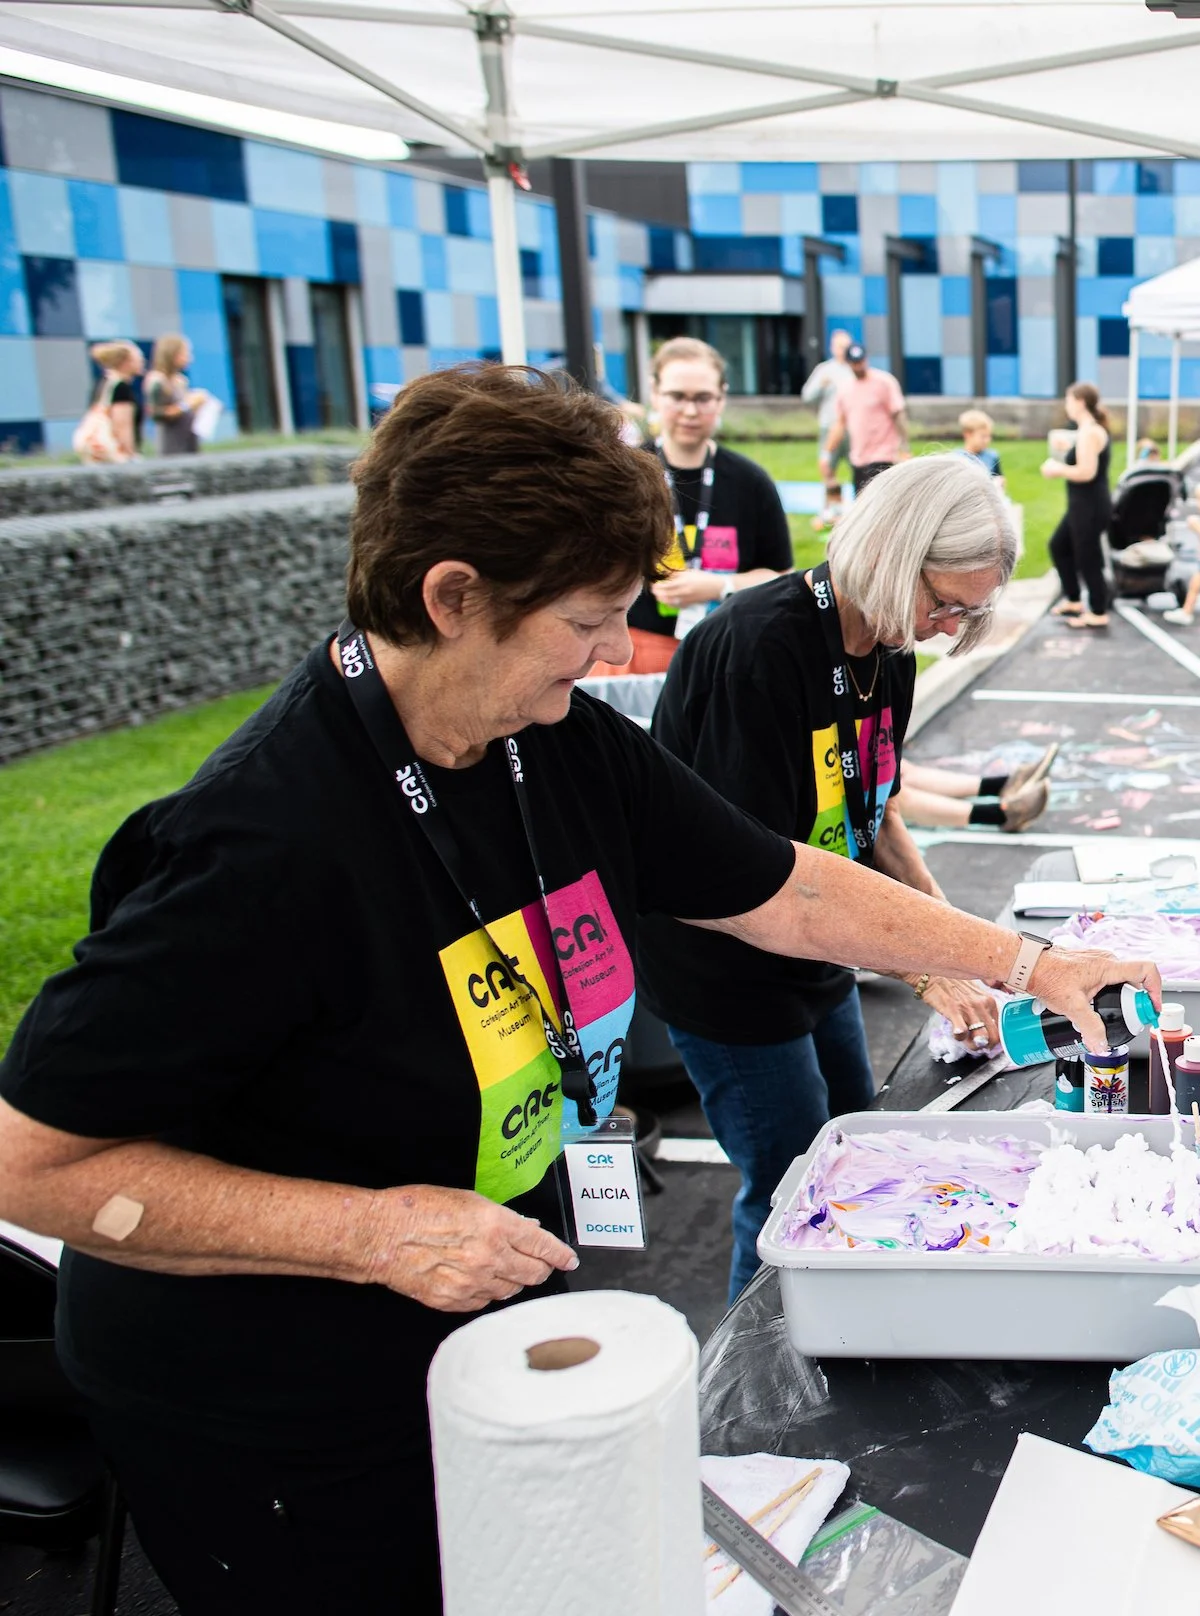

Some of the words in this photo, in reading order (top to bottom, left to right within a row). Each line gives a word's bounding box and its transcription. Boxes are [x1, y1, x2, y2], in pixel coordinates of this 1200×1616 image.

[1094, 1091, 1121, 1100] Color
[581, 1187, 631, 1200] ALICIA
[586, 1223, 635, 1233] DOCENT
